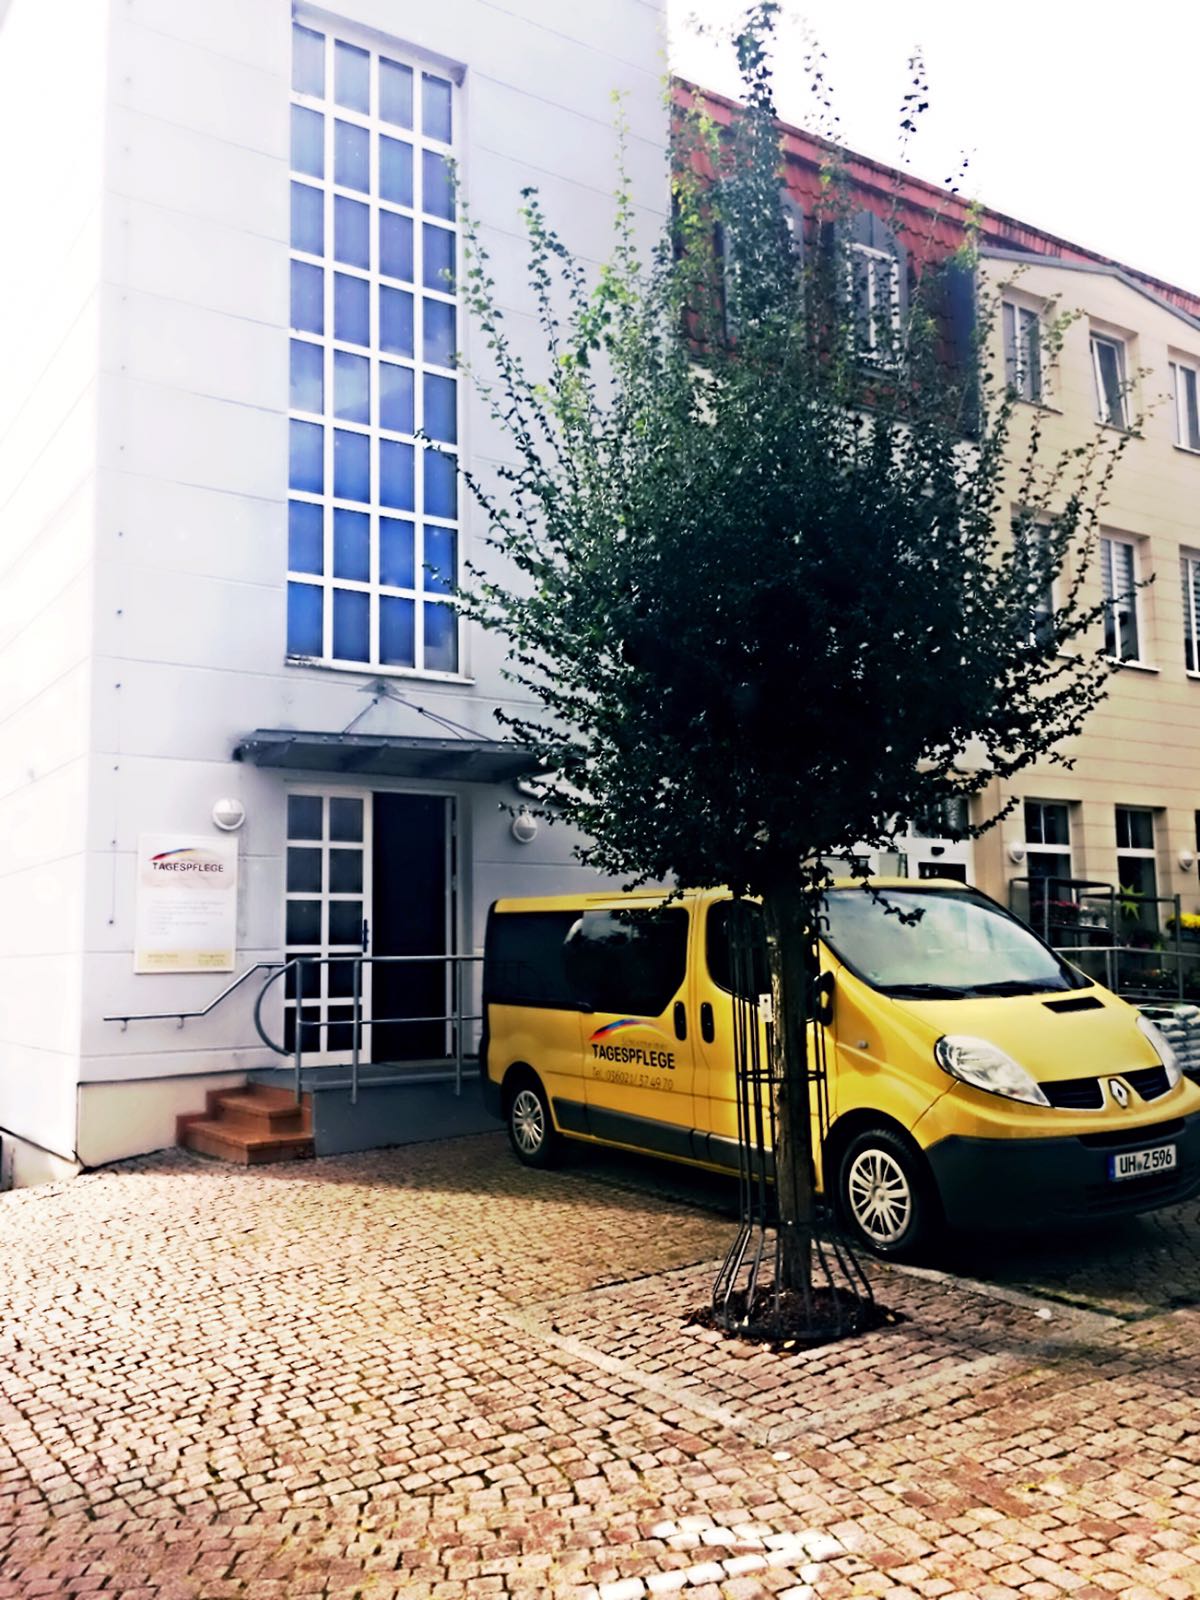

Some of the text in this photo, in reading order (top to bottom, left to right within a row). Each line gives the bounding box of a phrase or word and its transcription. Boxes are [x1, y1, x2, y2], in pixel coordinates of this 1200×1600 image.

[152, 862, 224, 873] TAGESPFLEGE
[592, 1043, 676, 1069] TAGESPFLEGE
[1119, 1155, 1136, 1174] UH
